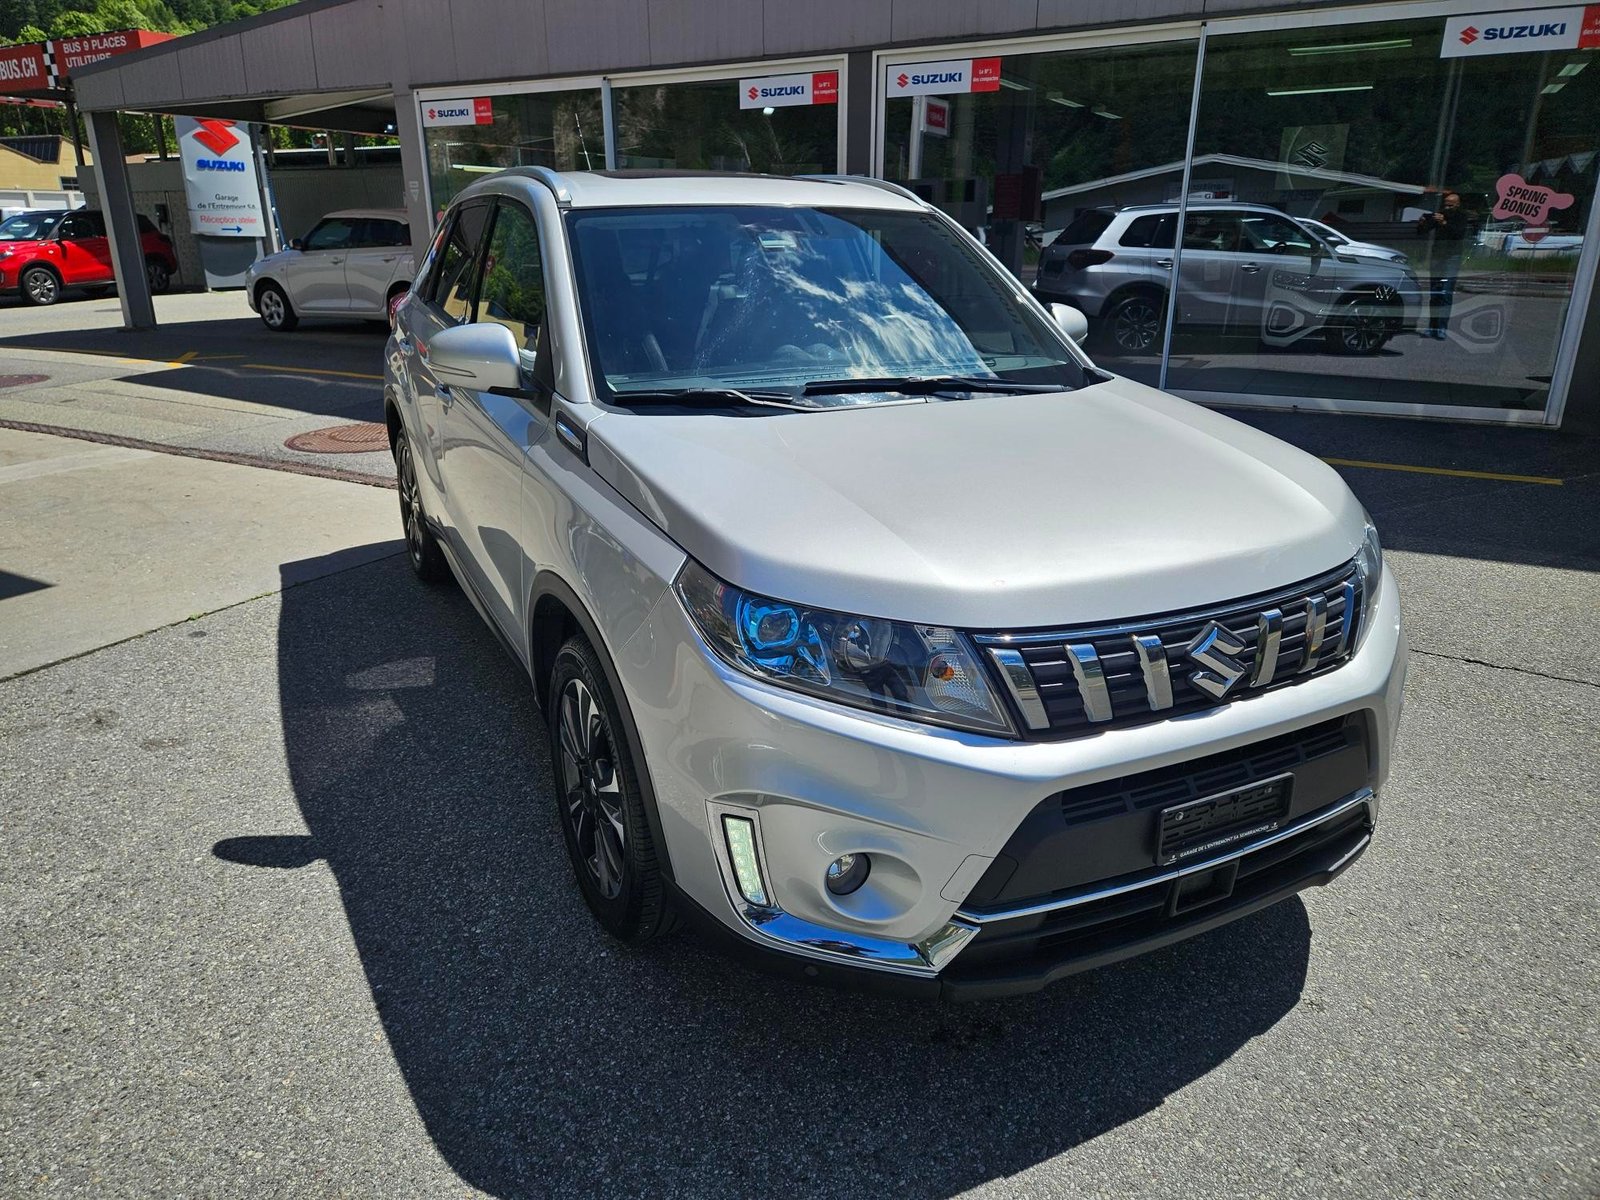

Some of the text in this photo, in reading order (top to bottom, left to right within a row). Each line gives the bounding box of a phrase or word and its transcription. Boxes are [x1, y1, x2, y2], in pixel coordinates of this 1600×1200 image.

[1483, 23, 1567, 41] SUZUKI
[63, 35, 127, 54] BUS 9 PLACES
[912, 72, 962, 85] SUZUKI
[761, 85, 805, 98] SUZUKI
[437, 108, 469, 118] SUZUKI
[196, 159, 245, 172] SUZUKI
[214, 193, 239, 203] Garage
[1506, 185, 1549, 205] SPRING
[1500, 198, 1542, 218] BONUS
